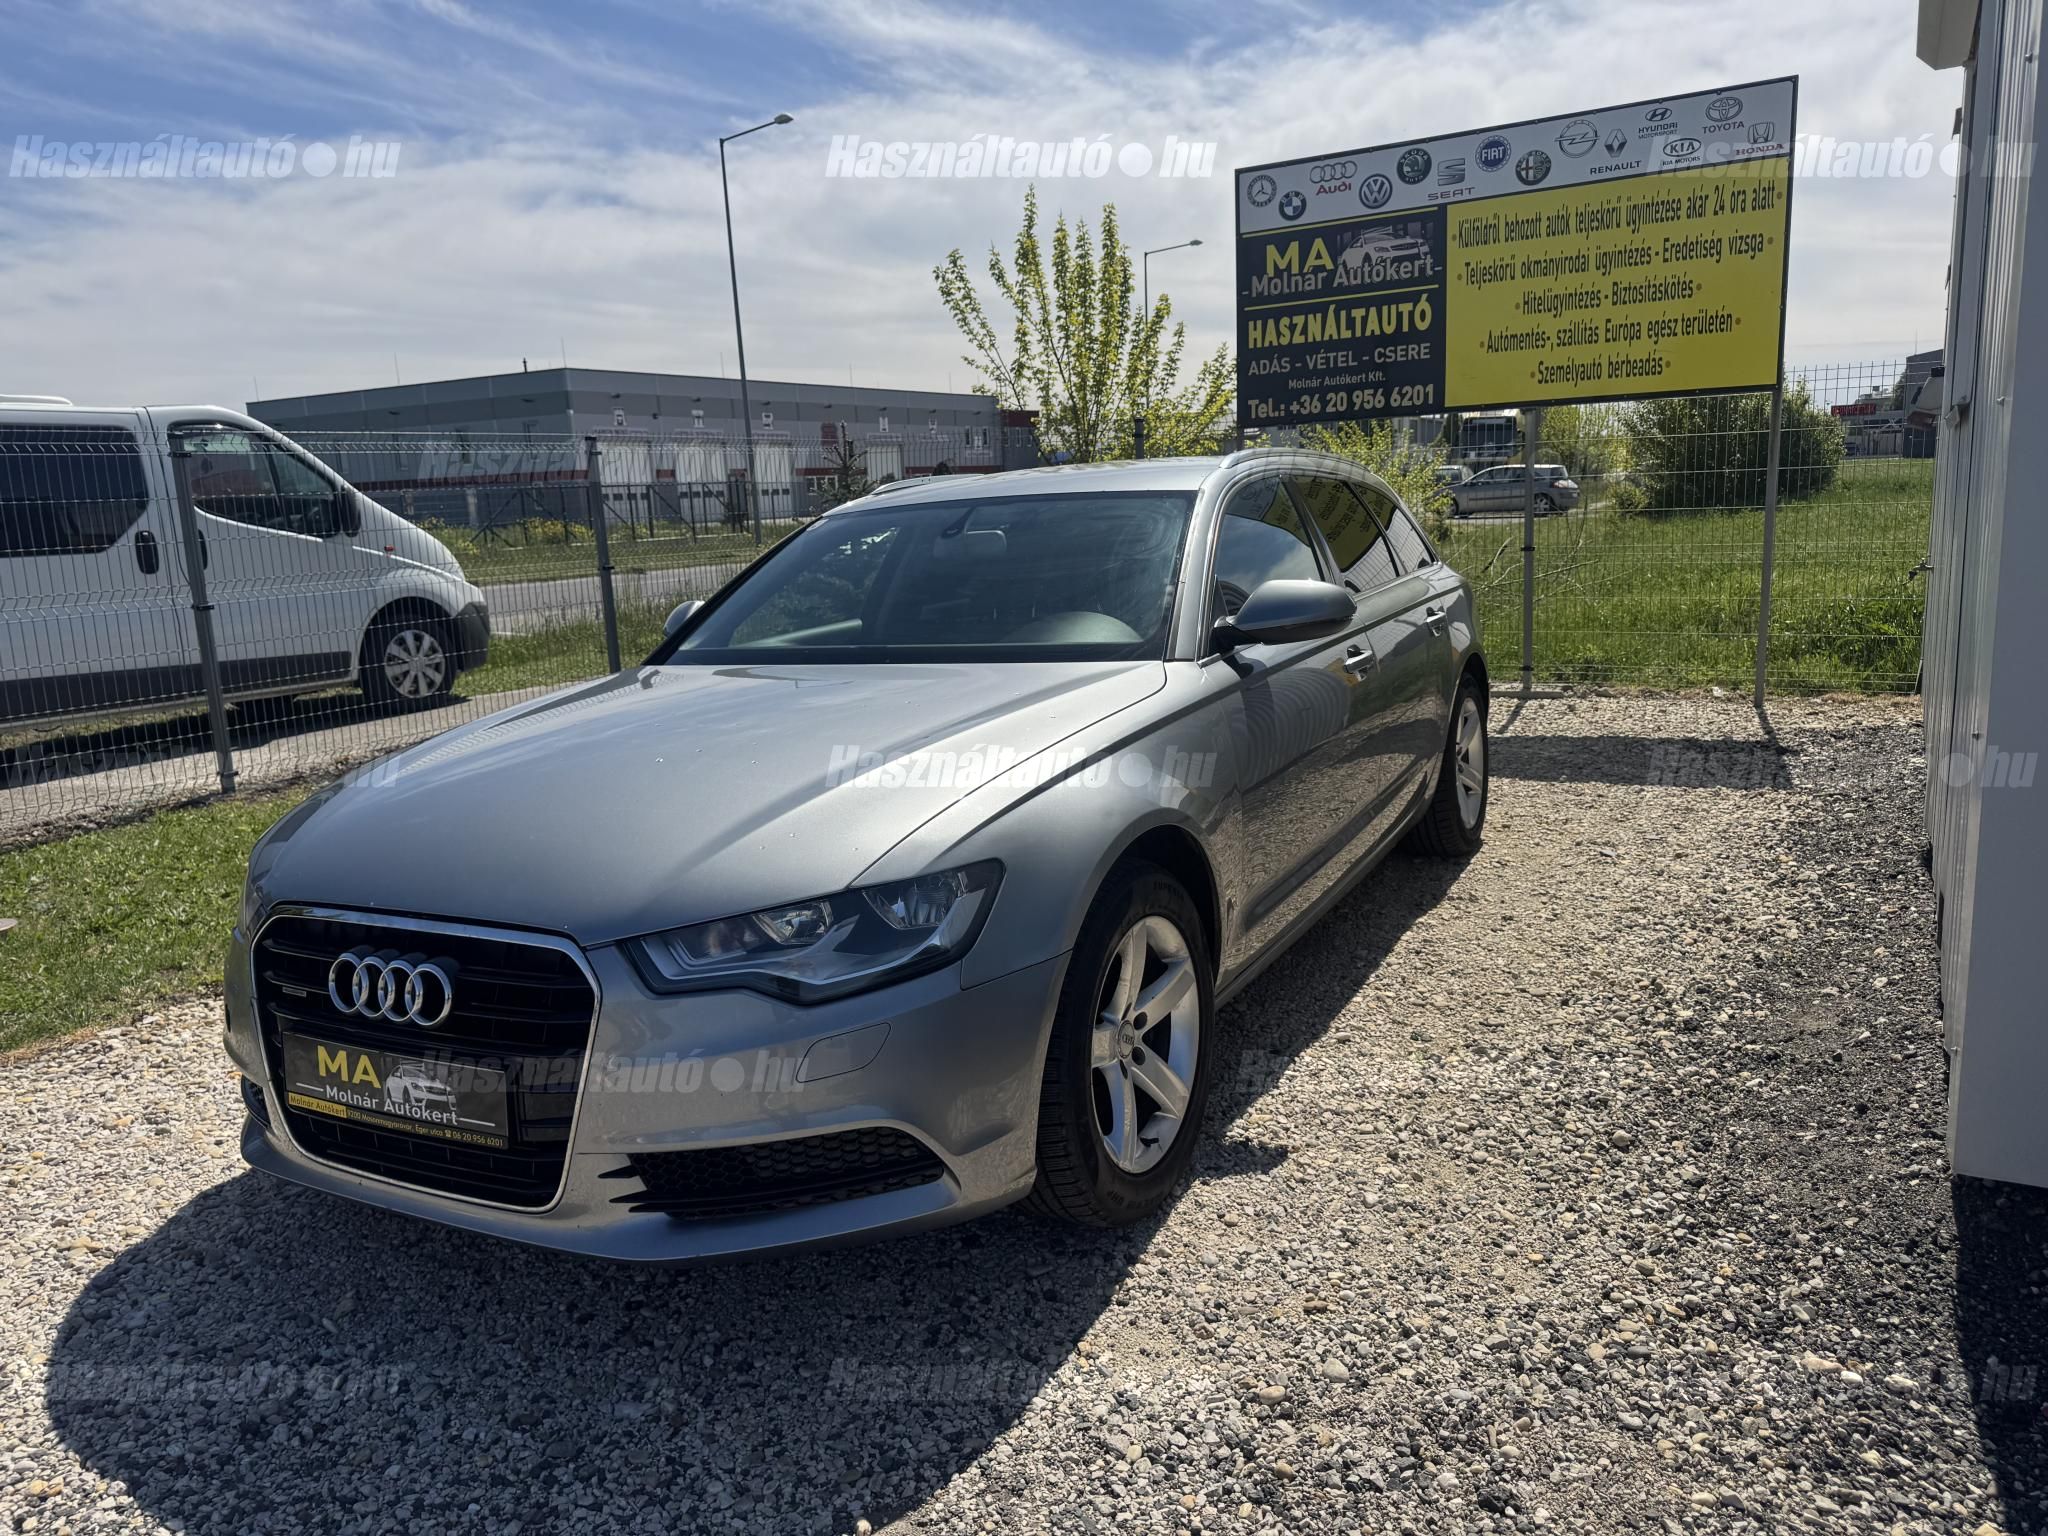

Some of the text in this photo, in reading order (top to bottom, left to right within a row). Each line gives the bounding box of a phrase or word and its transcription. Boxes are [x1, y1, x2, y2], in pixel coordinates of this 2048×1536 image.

[1638, 122, 1678, 134] HYUNDAI
[1638, 130, 1678, 140] MOTORSPORT
[1702, 121, 1745, 134] TOYOTA
[1481, 147, 1504, 161] FIAT
[1670, 141, 1695, 155] KIA
[1735, 143, 1785, 156] HONDA
[1590, 160, 1641, 175] RENAULT
[1674, 156, 1701, 165] MOTORS
[1315, 182, 1352, 196] Audi
[1427, 187, 1476, 200] SEAT
[1458, 179, 1776, 249] Külföldről behozott autók teljeskörű ügyintézése akár 24 óra alatt
[1266, 237, 1335, 277] MA
[1464, 254, 1516, 290] Teljeskörű
[1520, 247, 1590, 282] okmányirodai
[1595, 238, 1652, 277] ügyintézés
[1662, 229, 1723, 264] Eredetiség
[1728, 229, 1764, 260] vizsga
[1522, 281, 1601, 319] Hitelügyintézés
[1611, 271, 1694, 306] Biztosításkötés
[1248, 293, 1432, 349] HASZNÁLTAUTÓ
[1556, 318, 1600, 348] szállítás
[1604, 314, 1642, 347] Európa
[1647, 310, 1678, 345] egész
[1681, 304, 1733, 336] területén
[1248, 353, 1291, 376] ADÁS
[1306, 349, 1358, 370] VÉTEL
[1374, 343, 1431, 363] CSERE
[1537, 348, 1663, 388] Személyautó bérbeadás
[1288, 371, 1386, 390] Molnár Autókert Kft.
[1248, 384, 1434, 419] Tel.: +36 20 956 6201
[317, 1044, 381, 1089] MA
[325, 1084, 458, 1126] Molnár Autókert
[462, 1133, 471, 1142] 20
[487, 1138, 503, 1147] 6201
